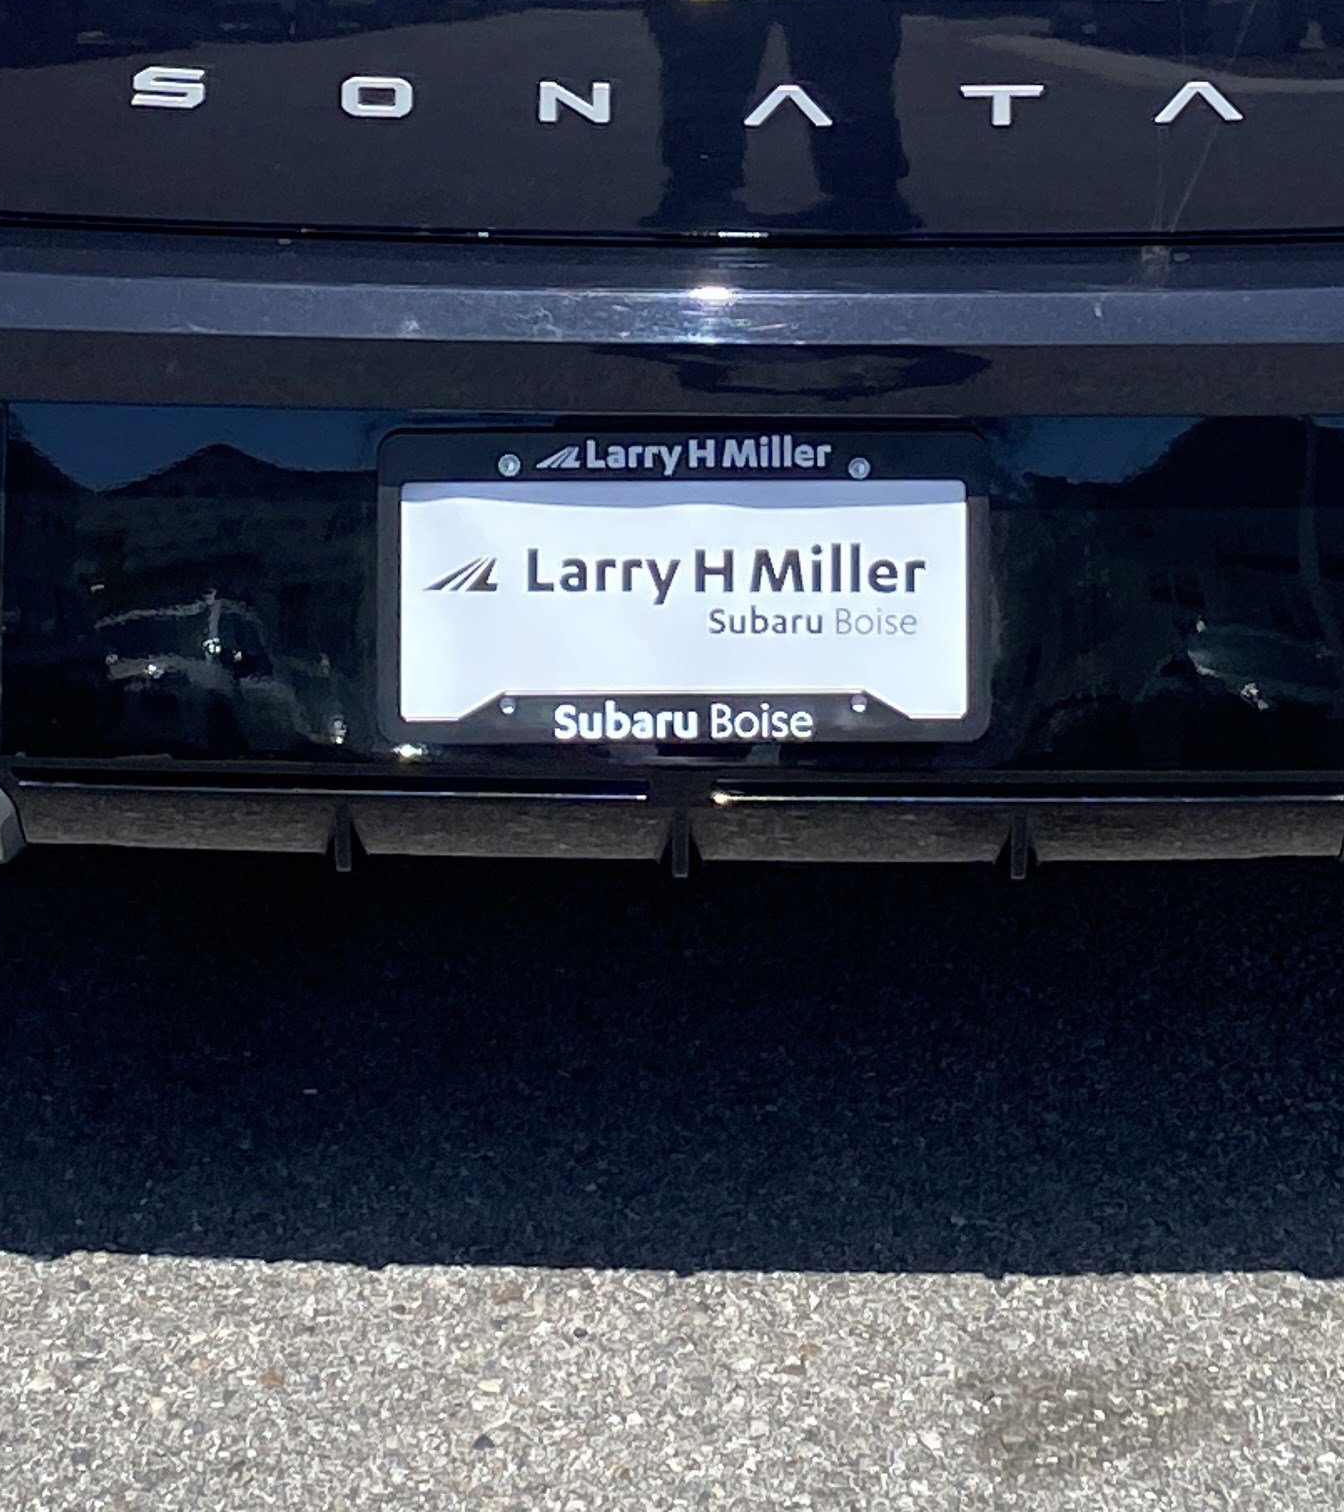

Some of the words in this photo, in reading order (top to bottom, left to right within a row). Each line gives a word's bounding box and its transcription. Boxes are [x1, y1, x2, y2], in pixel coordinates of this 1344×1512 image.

[130, 66, 1245, 128] SONATA
[586, 439, 682, 476] Larry
[688, 439, 716, 468] H
[721, 434, 832, 468] Miller
[527, 548, 681, 606] Larry
[695, 549, 734, 593] H
[750, 543, 927, 594] Miller
[708, 605, 824, 635] Subaru
[835, 606, 918, 636] Boise
[554, 699, 699, 740] Subaru
[710, 702, 814, 739] Boise
